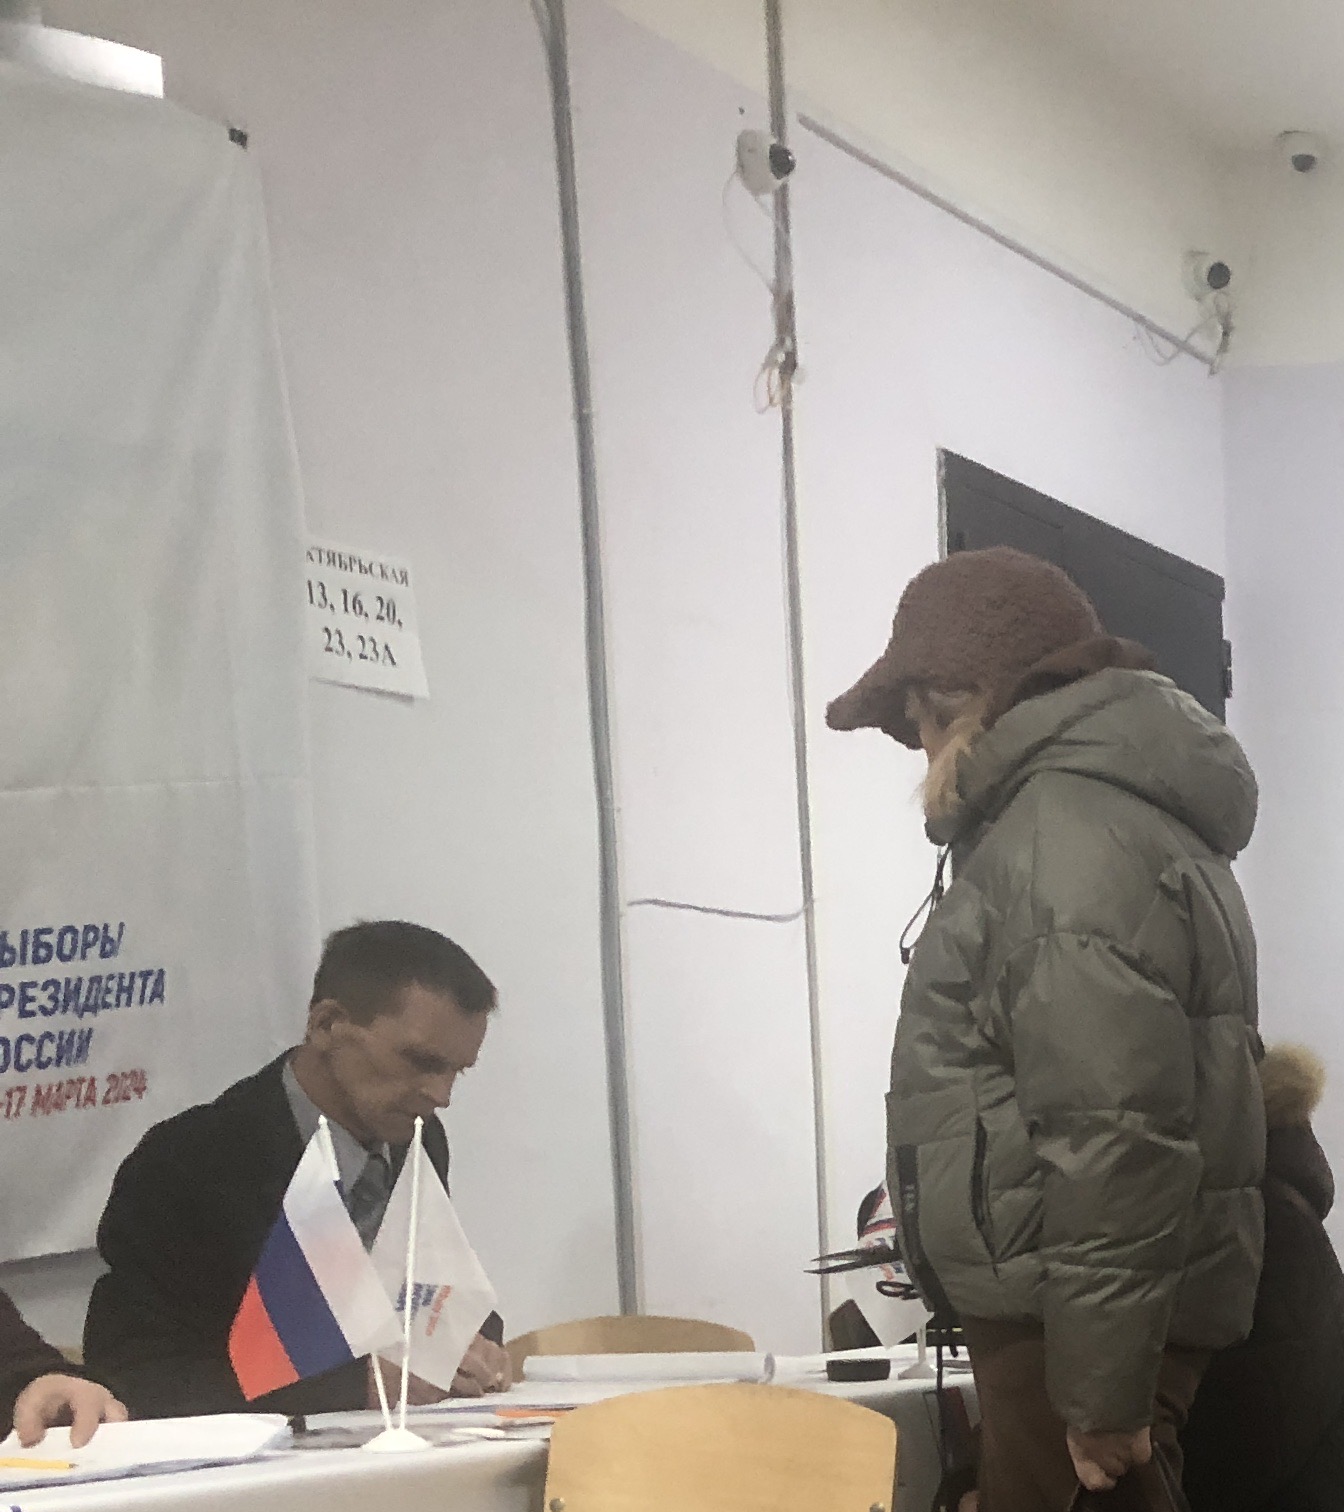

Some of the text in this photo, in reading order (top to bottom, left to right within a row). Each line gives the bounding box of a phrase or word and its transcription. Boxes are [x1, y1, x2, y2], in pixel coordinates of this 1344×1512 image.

[307, 580, 335, 613] 13,
[322, 626, 352, 664] 23,
[30, 1076, 97, 1117] МАРТА
